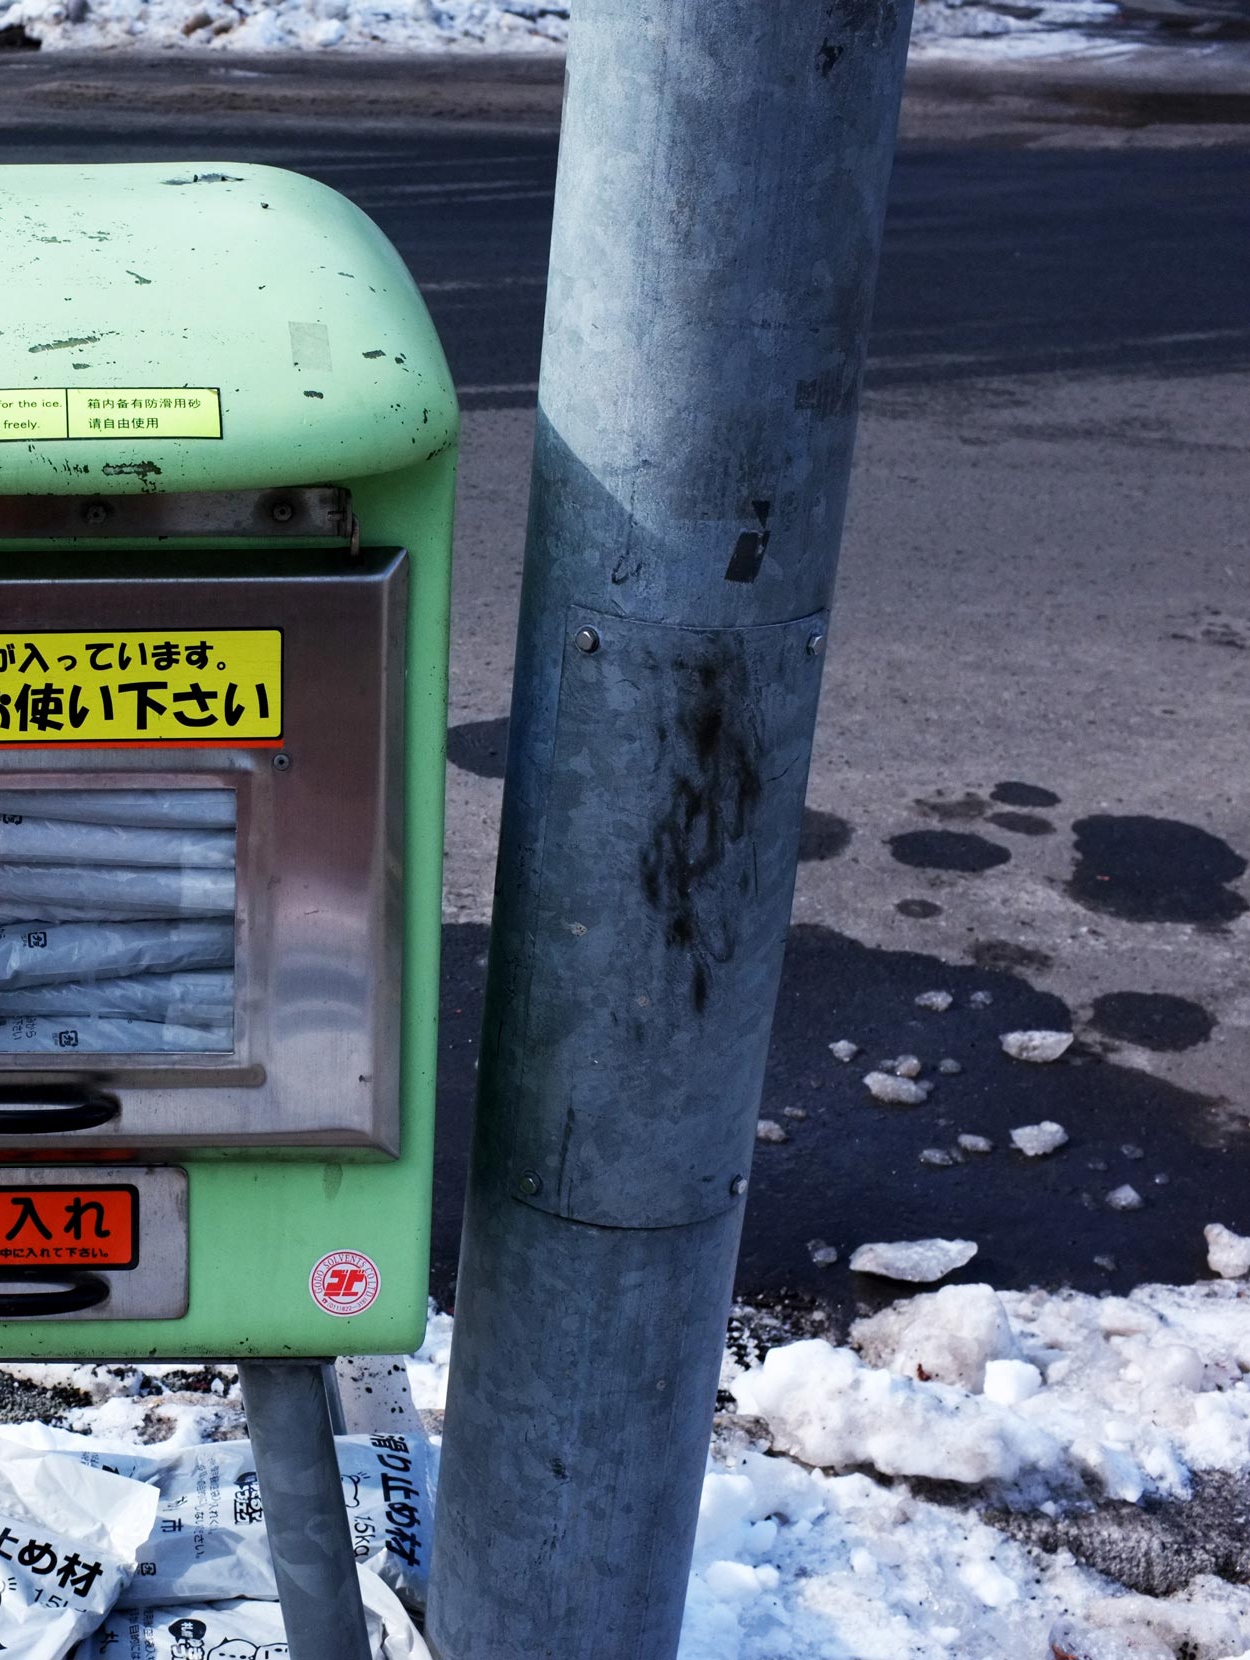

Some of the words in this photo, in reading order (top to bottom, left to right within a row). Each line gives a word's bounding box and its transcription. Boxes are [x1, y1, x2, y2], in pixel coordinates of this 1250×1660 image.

[18, 399, 37, 408] the
[42, 399, 63, 408] ice.
[87, 398, 202, 409] 箱内备有防滑用砂
[3, 419, 41, 431] freely.
[88, 417, 159, 430] 请自由使用
[314, 1269, 325, 1294] GODO
[323, 1254, 367, 1269] SOLVENTS
[369, 1433, 422, 1567] 滑り止め材
